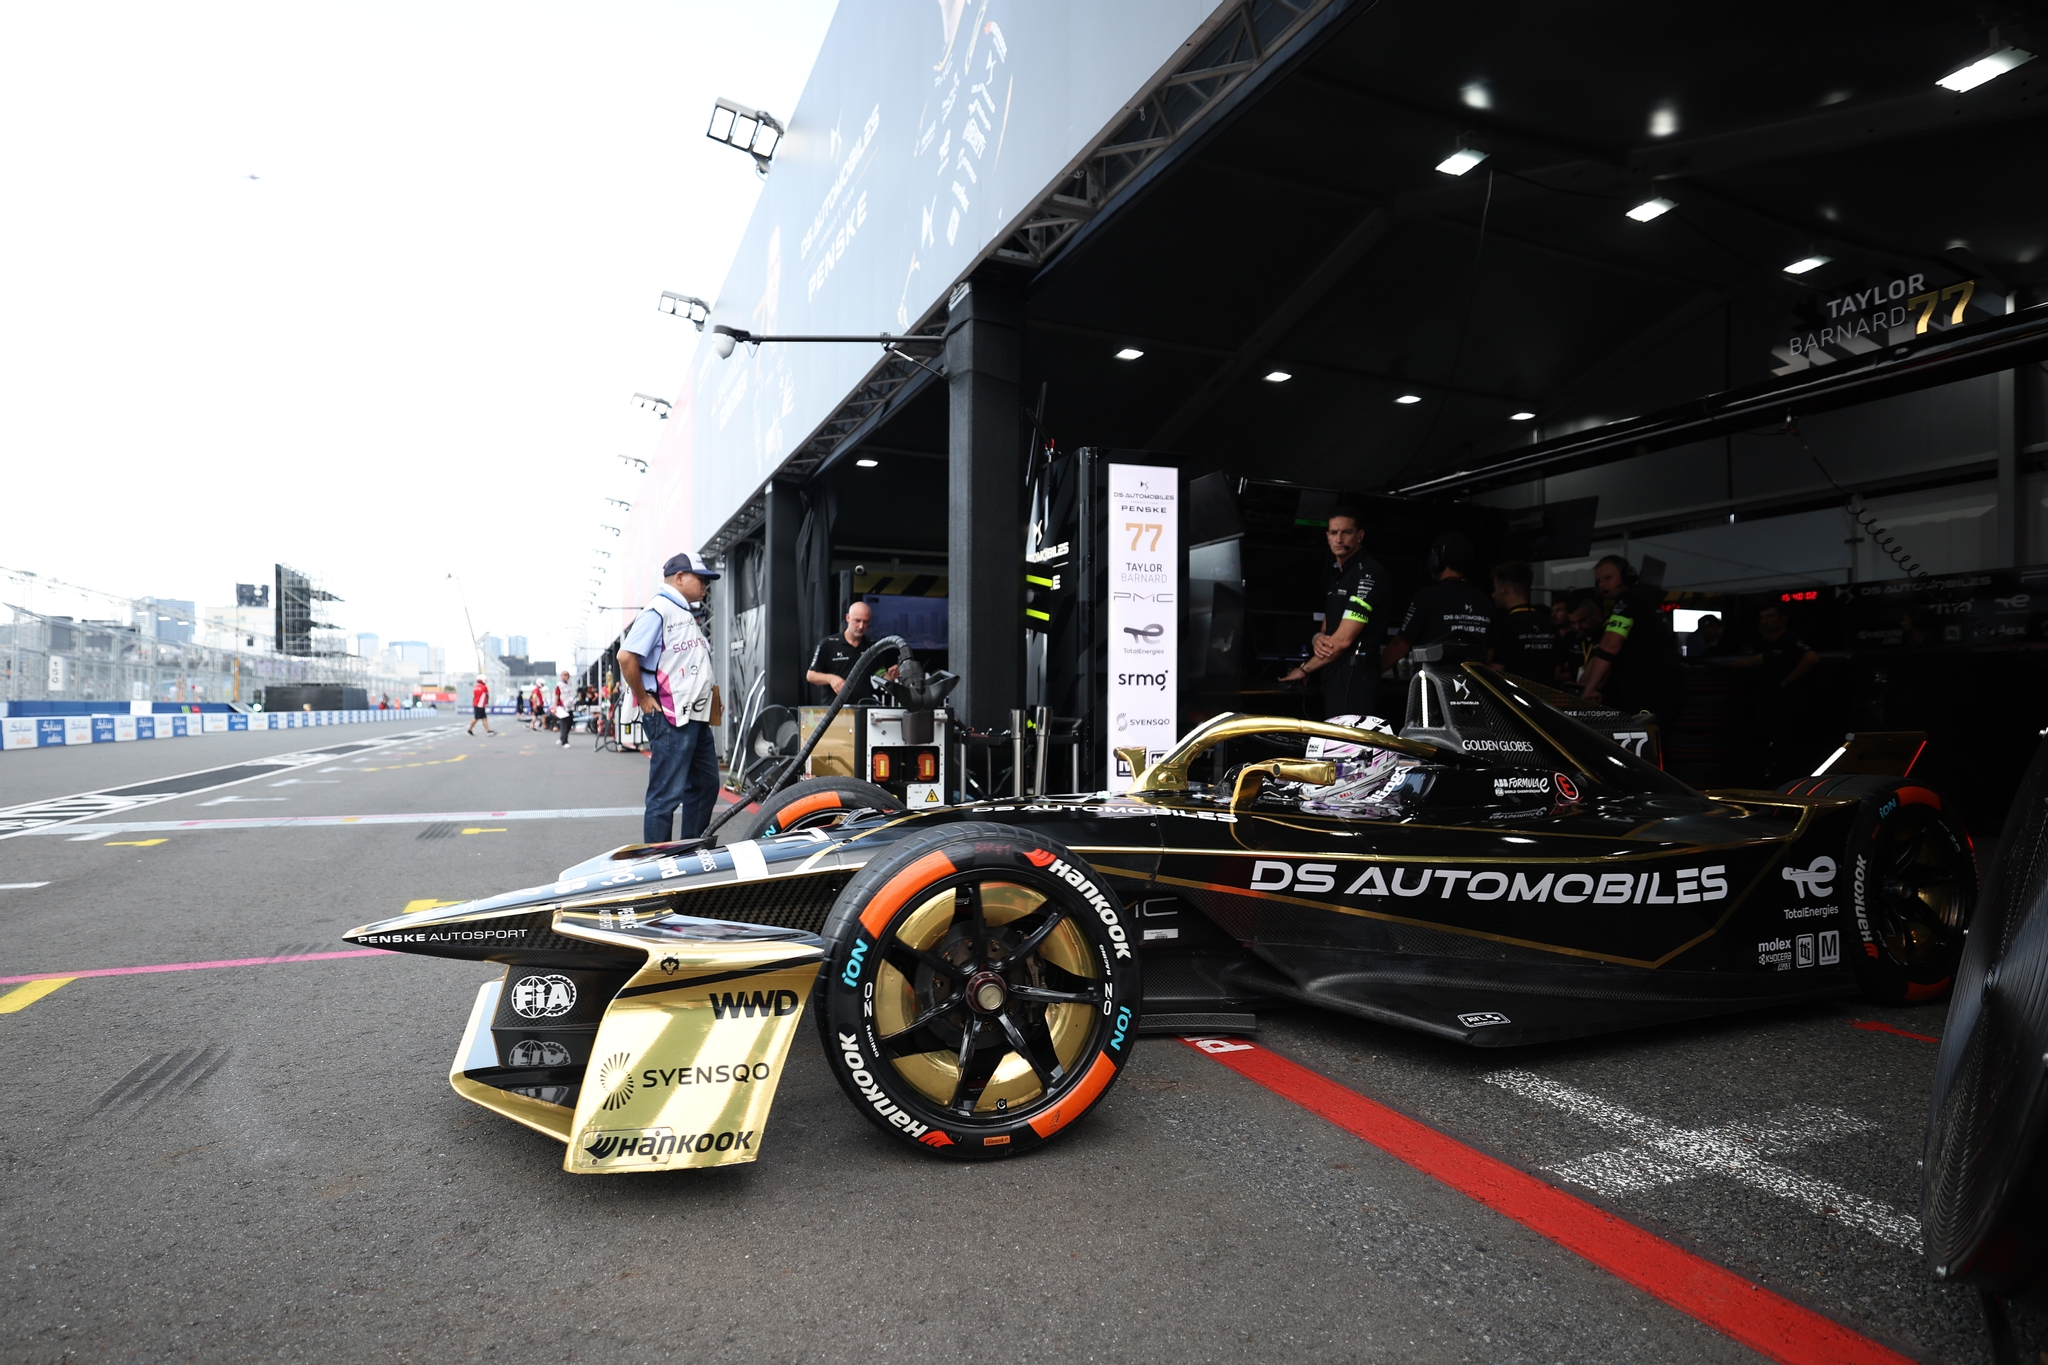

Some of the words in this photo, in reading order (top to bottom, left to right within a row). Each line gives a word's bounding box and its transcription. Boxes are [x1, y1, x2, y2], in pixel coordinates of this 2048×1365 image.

[808, 189, 868, 304] PENSKE
[1826, 273, 1926, 319] TAYLOR
[1788, 306, 1907, 356] BARNARD
[1907, 279, 1976, 335] 77
[1121, 505, 1167, 513] PENSKE
[1125, 522, 1164, 552] 77
[1126, 562, 1163, 573] TAYLOR
[1120, 572, 1168, 584] BARNARD
[1113, 591, 1174, 603] PMC
[1118, 670, 1169, 691] srmg
[1129, 717, 1171, 727] SYENSQO
[1462, 739, 1499, 751] GOLDEN
[1499, 741, 1534, 752] GLOBES
[1612, 731, 1649, 758] 77
[1508, 777, 1540, 788] FORMULA
[1019, 804, 1239, 823] AUTOMOBILES
[1249, 860, 1338, 893] DS
[1343, 865, 1728, 905] AUTOMOBILES
[1783, 904, 1839, 920] TotalEnergies
[357, 932, 426, 944] PENSKE
[427, 928, 529, 943] AUTOSPORT
[1758, 937, 1792, 952] molex
[1821, 933, 1837, 958] M
[1765, 951, 1792, 963] KYOCERA
[708, 990, 799, 1020] WWD
[865, 1024, 880, 1059] RACING
[641, 1062, 771, 1089] SYENSQO
